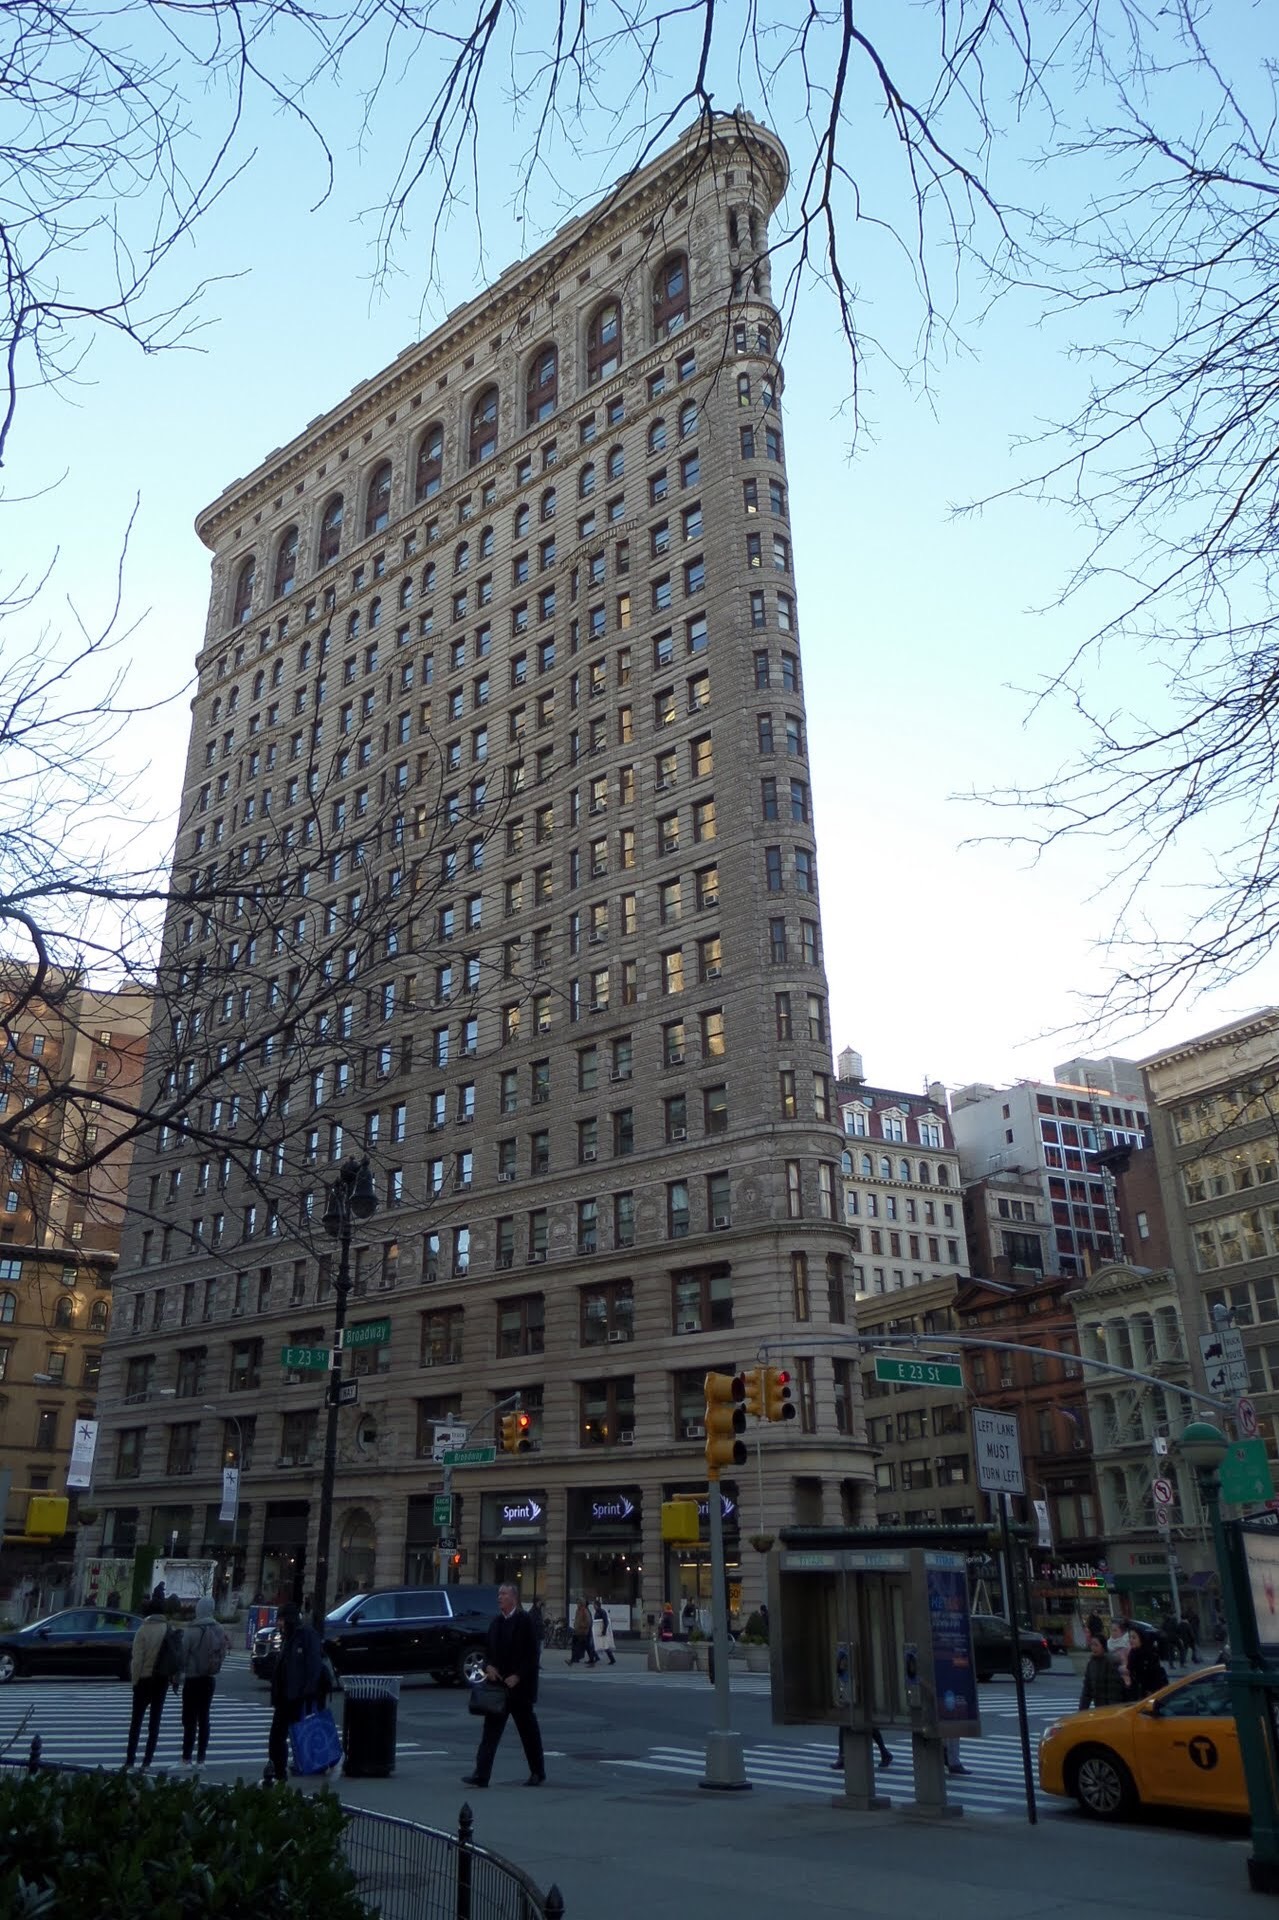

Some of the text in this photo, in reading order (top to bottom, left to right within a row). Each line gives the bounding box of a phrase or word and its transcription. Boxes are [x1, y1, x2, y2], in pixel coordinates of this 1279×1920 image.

[346, 1326, 386, 1343] Broadway
[286, 1349, 294, 1364] E
[299, 1350, 312, 1366] 23
[898, 1363, 941, 1381] E 23 St
[977, 1420, 1015, 1437] LEFT LANE
[454, 1450, 483, 1462] Broadway
[986, 1442, 1010, 1459] MUST
[981, 1466, 1019, 1484] TURN LEFT
[503, 1504, 530, 1521] Sprint
[592, 1501, 621, 1519] Sprint
